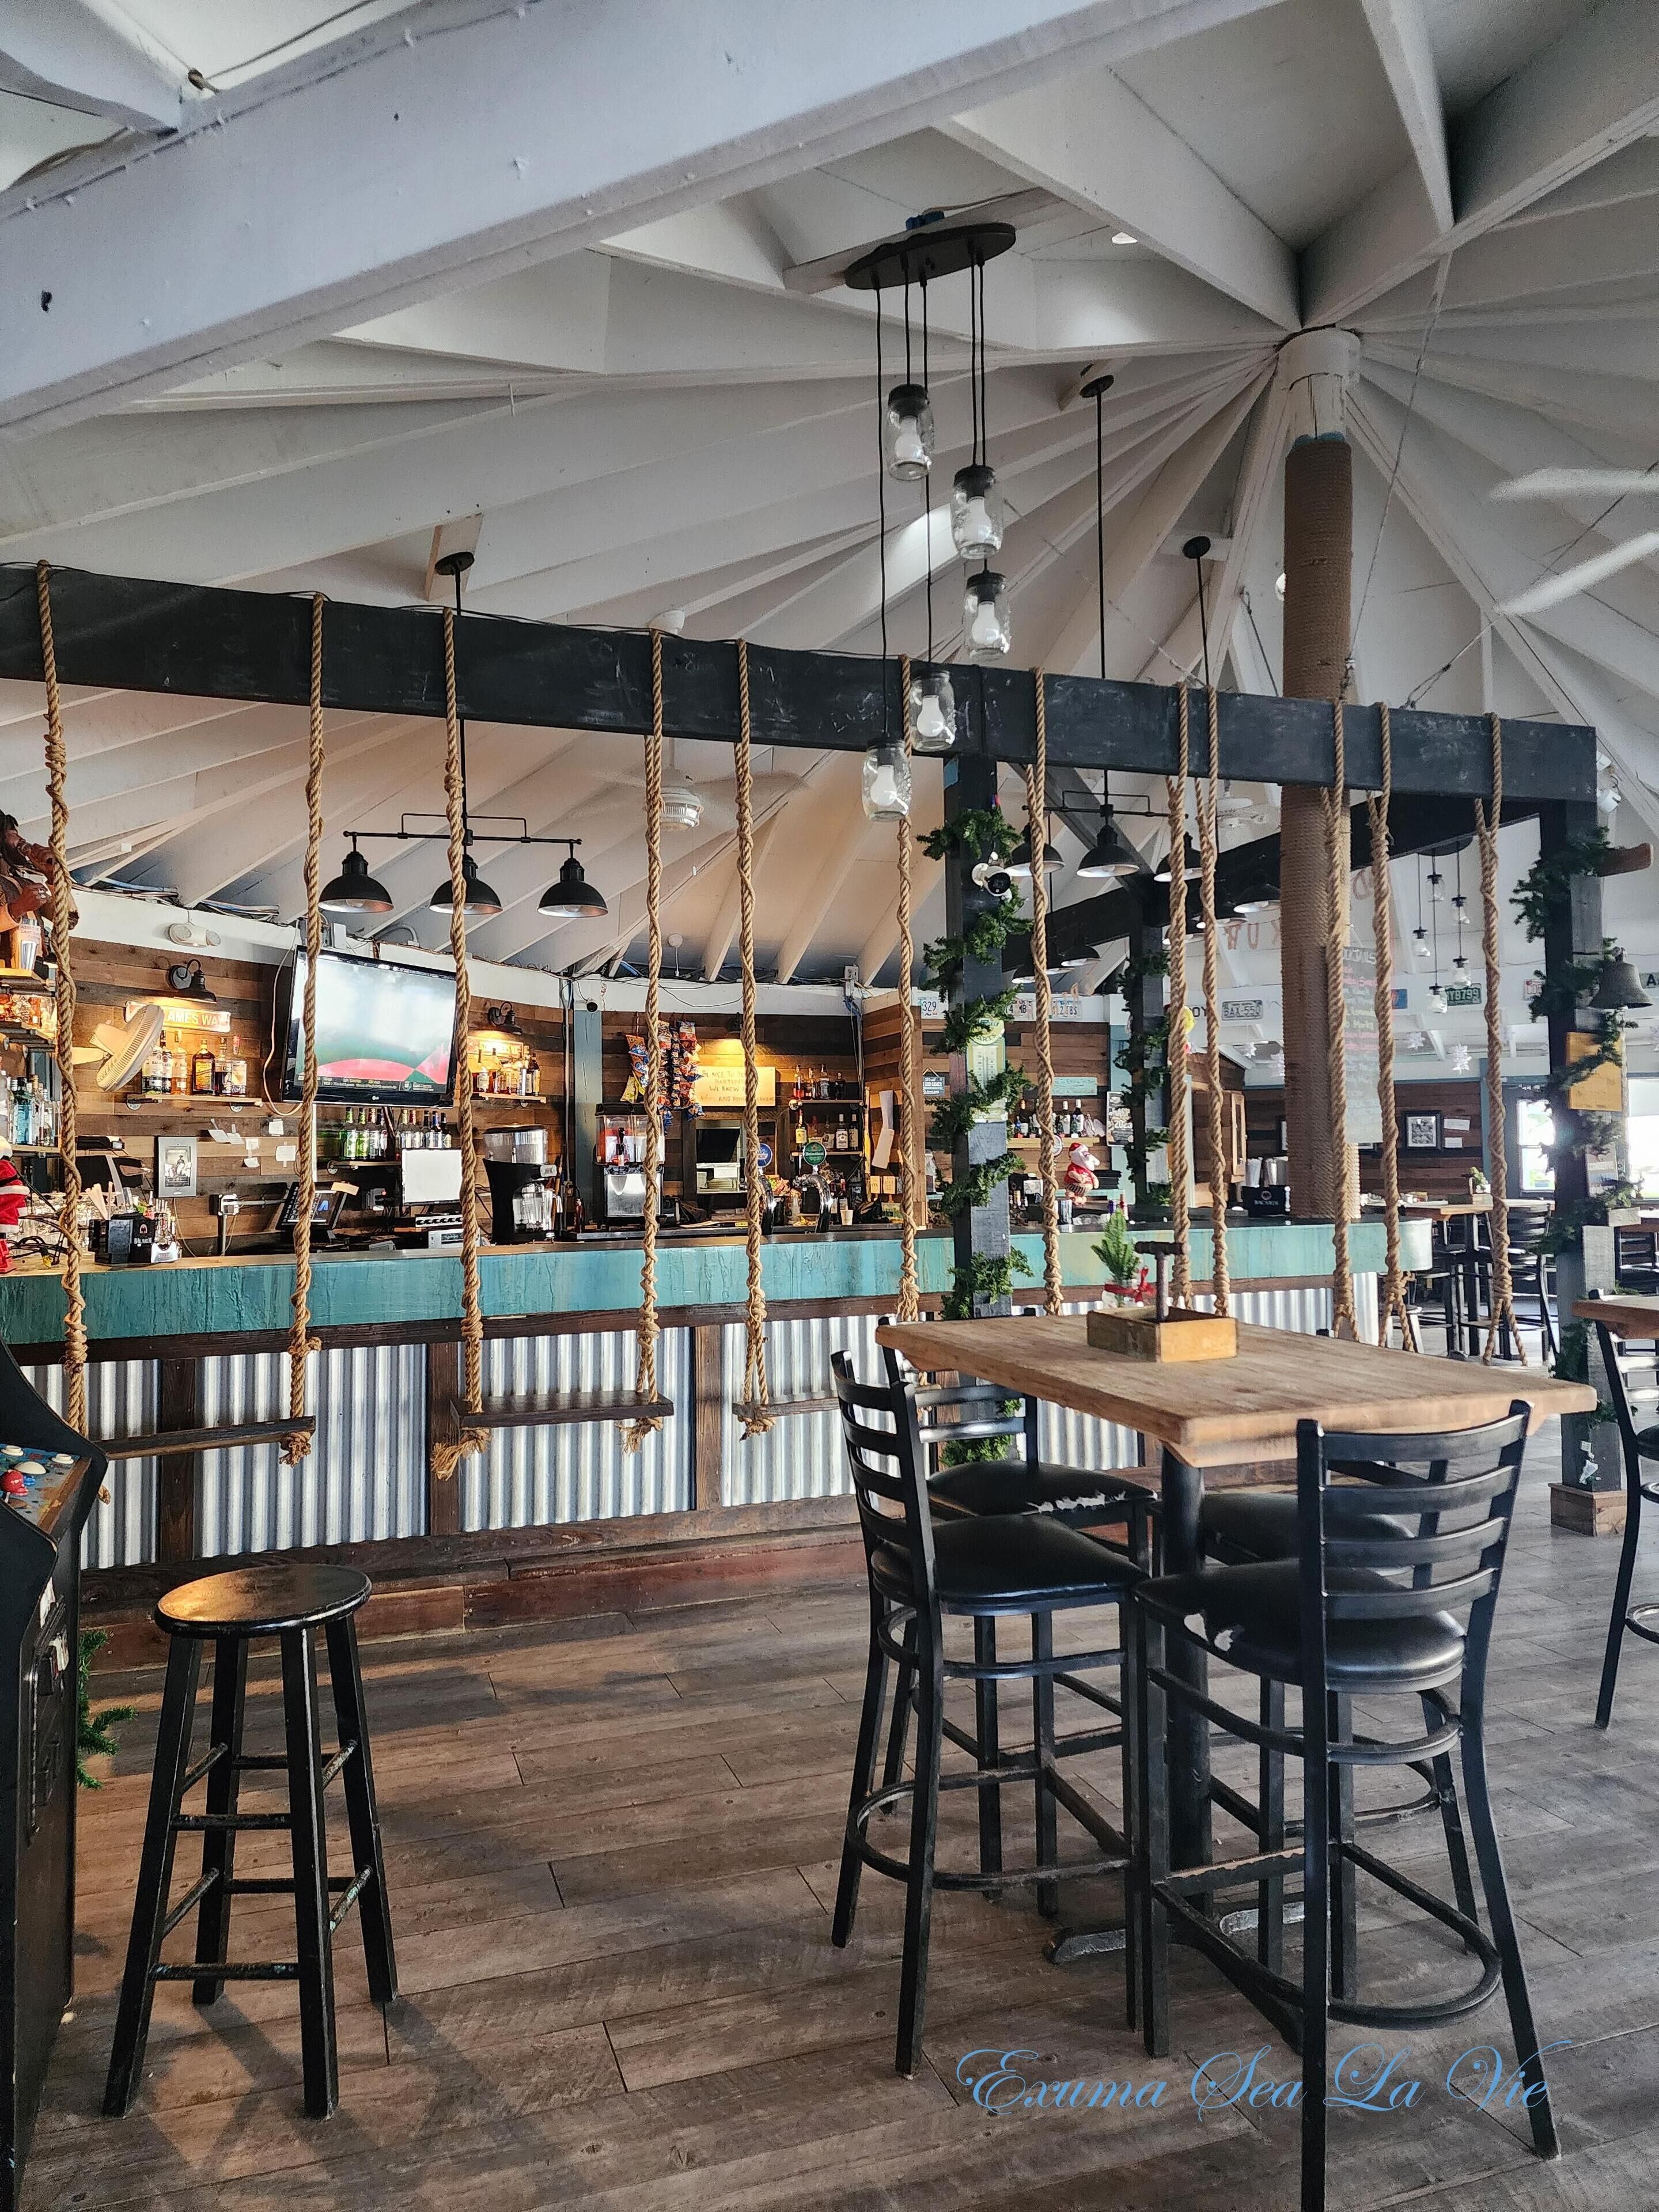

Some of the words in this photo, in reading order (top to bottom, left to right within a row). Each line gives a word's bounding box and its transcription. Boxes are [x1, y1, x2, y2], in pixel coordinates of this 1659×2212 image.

[1646, 974, 1659, 986] A
[1189, 1006, 1207, 1017] OY
[165, 1009, 199, 1024] AMES
[201, 1013, 222, 1027] WAY
